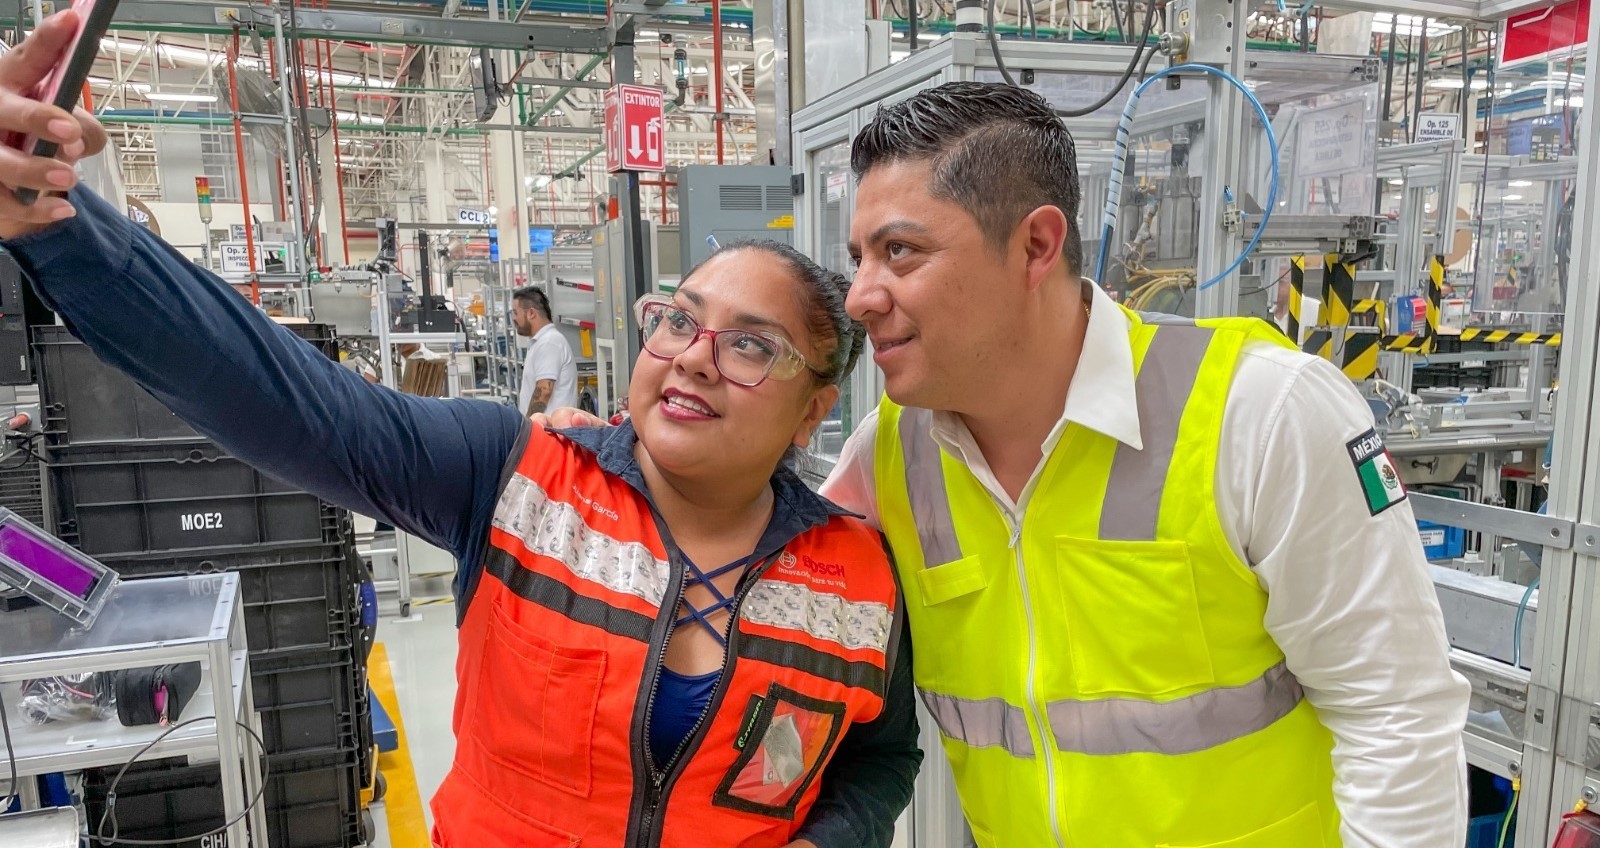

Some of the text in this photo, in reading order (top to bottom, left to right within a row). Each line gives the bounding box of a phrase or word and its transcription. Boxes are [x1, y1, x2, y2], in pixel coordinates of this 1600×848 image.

[624, 92, 660, 108] EXTINTOR
[1427, 120, 1449, 130] Op. 125
[460, 210, 489, 224] CCL 2
[227, 246, 257, 255] Op. 25
[591, 501, 619, 521] García
[181, 512, 224, 531] MOE2
[802, 555, 845, 577] BOSCH
